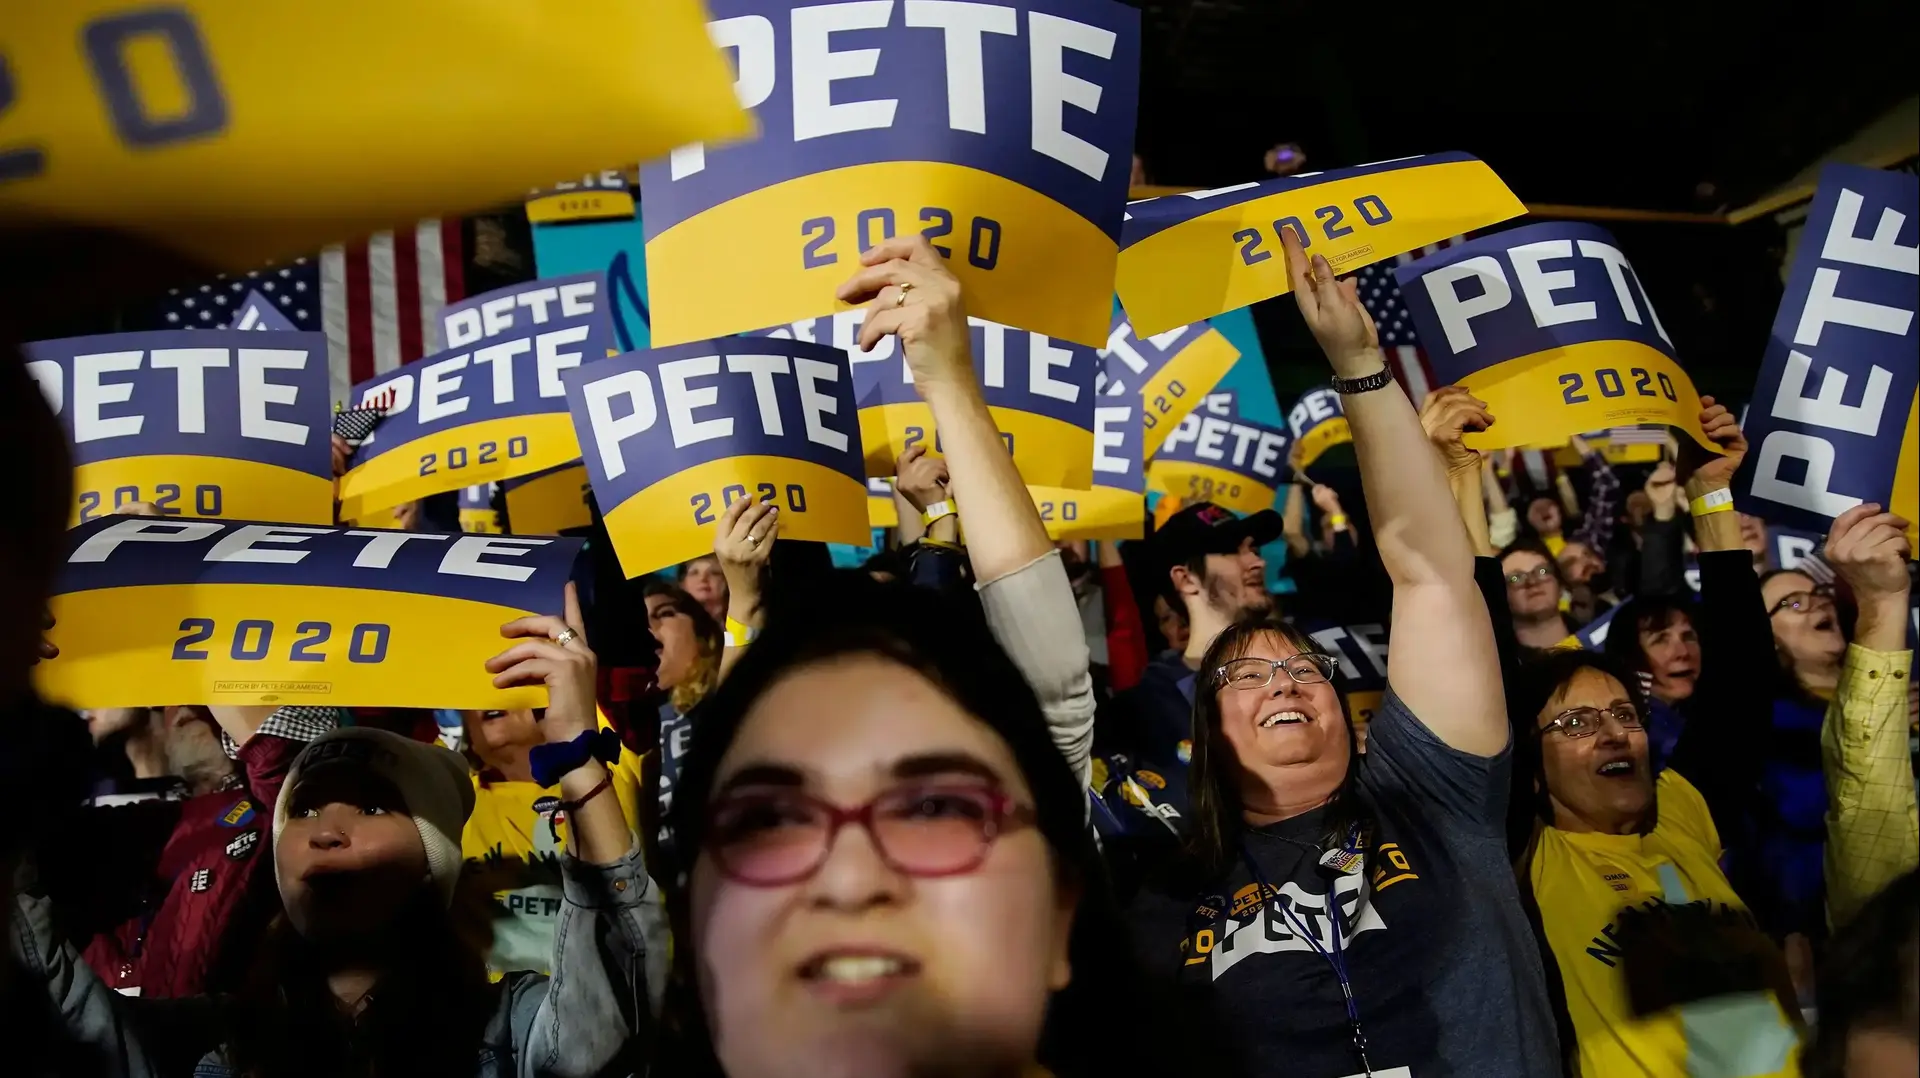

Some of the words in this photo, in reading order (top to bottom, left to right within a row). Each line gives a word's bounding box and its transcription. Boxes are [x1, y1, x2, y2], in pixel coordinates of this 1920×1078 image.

[802, 207, 1001, 271] 2020
[1233, 194, 1393, 266] 2020
[1422, 239, 1676, 355] PET
[833, 308, 1080, 403] PTE
[1750, 187, 1919, 518] PETE
[1558, 367, 1678, 405] 2020
[583, 355, 848, 481] PETE
[420, 436, 528, 476] 2020
[1163, 413, 1287, 478] PETE
[79, 484, 222, 524] 2020
[690, 483, 807, 526] 2020
[68, 520, 554, 581] PETE
[171, 618, 391, 664] 2020
[261, 683, 278, 691] PETE
[226, 832, 257, 855] PETE
[197, 868, 209, 891] PETE
[1233, 888, 1274, 911] PETE
[508, 895, 562, 917] PET
[1195, 905, 1220, 919] PETE
